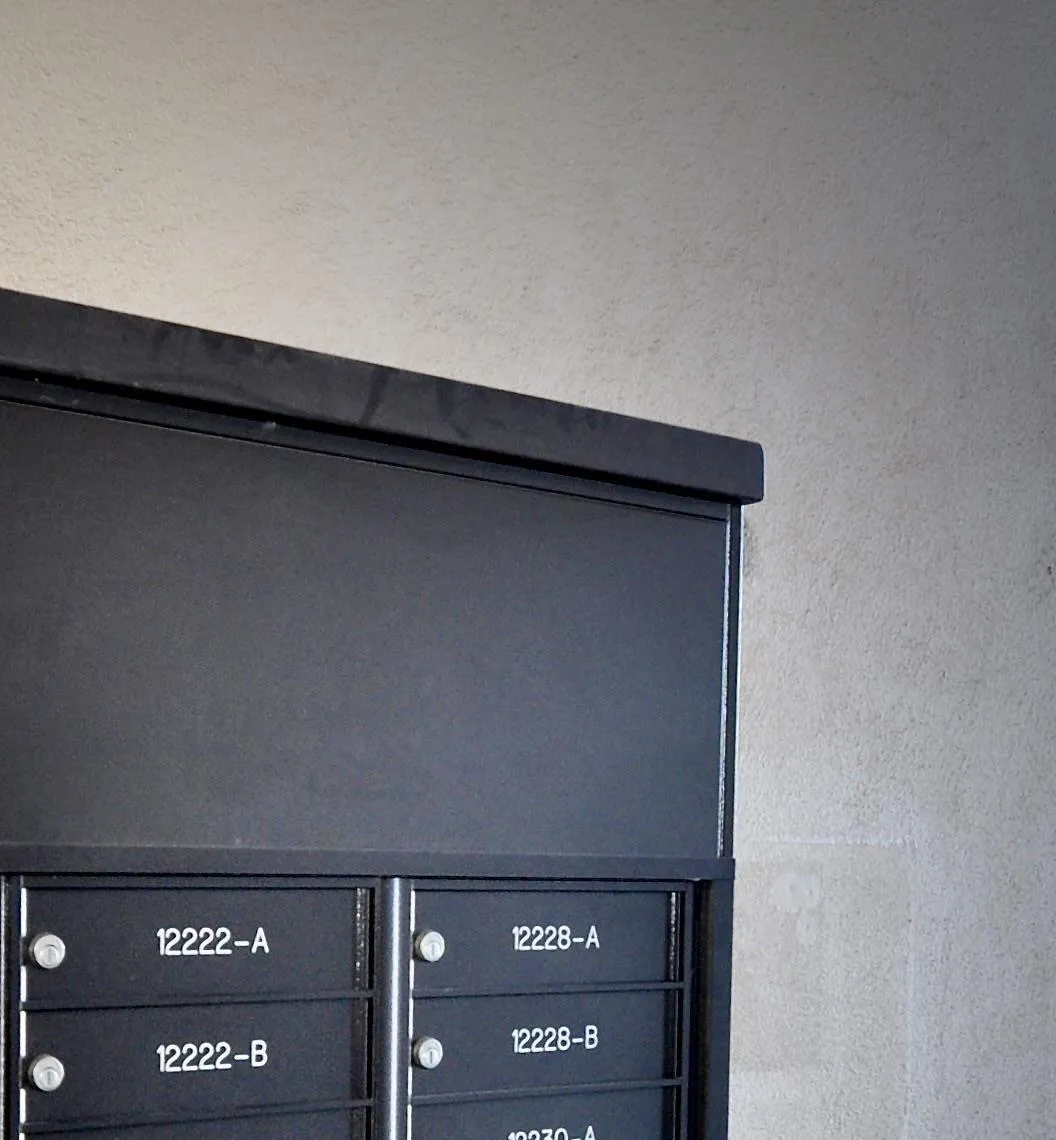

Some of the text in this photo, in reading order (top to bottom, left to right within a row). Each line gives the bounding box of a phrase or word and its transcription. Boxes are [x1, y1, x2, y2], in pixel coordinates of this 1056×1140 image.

[156, 926, 270, 956] 12222-A
[511, 924, 601, 952] 12228-A
[511, 1024, 599, 1054] 12228-B
[156, 1039, 269, 1073] 12222-B
